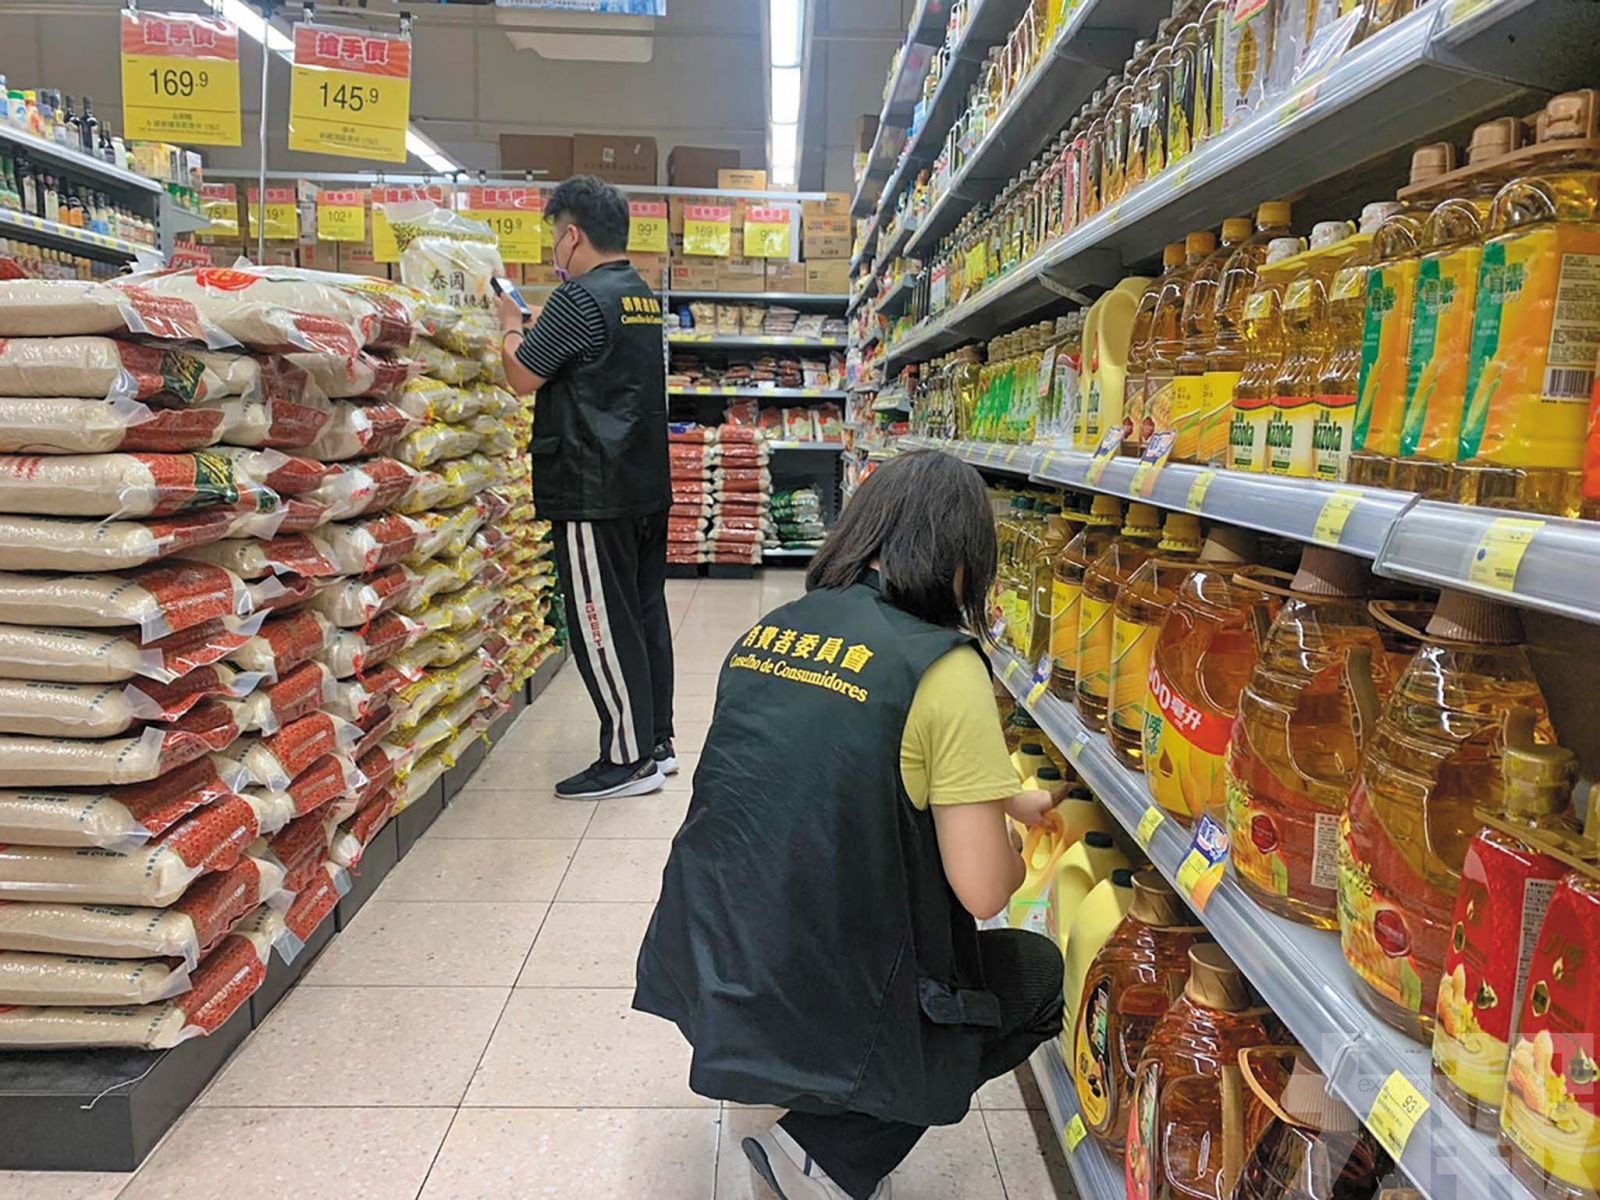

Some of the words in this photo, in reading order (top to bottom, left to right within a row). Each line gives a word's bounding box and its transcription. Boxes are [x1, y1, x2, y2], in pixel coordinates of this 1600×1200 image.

[149, 68, 208, 97] 169.9
[319, 81, 380, 112] 145.9
[761, 656, 775, 674] de
[773, 660, 869, 702] Consumidores
